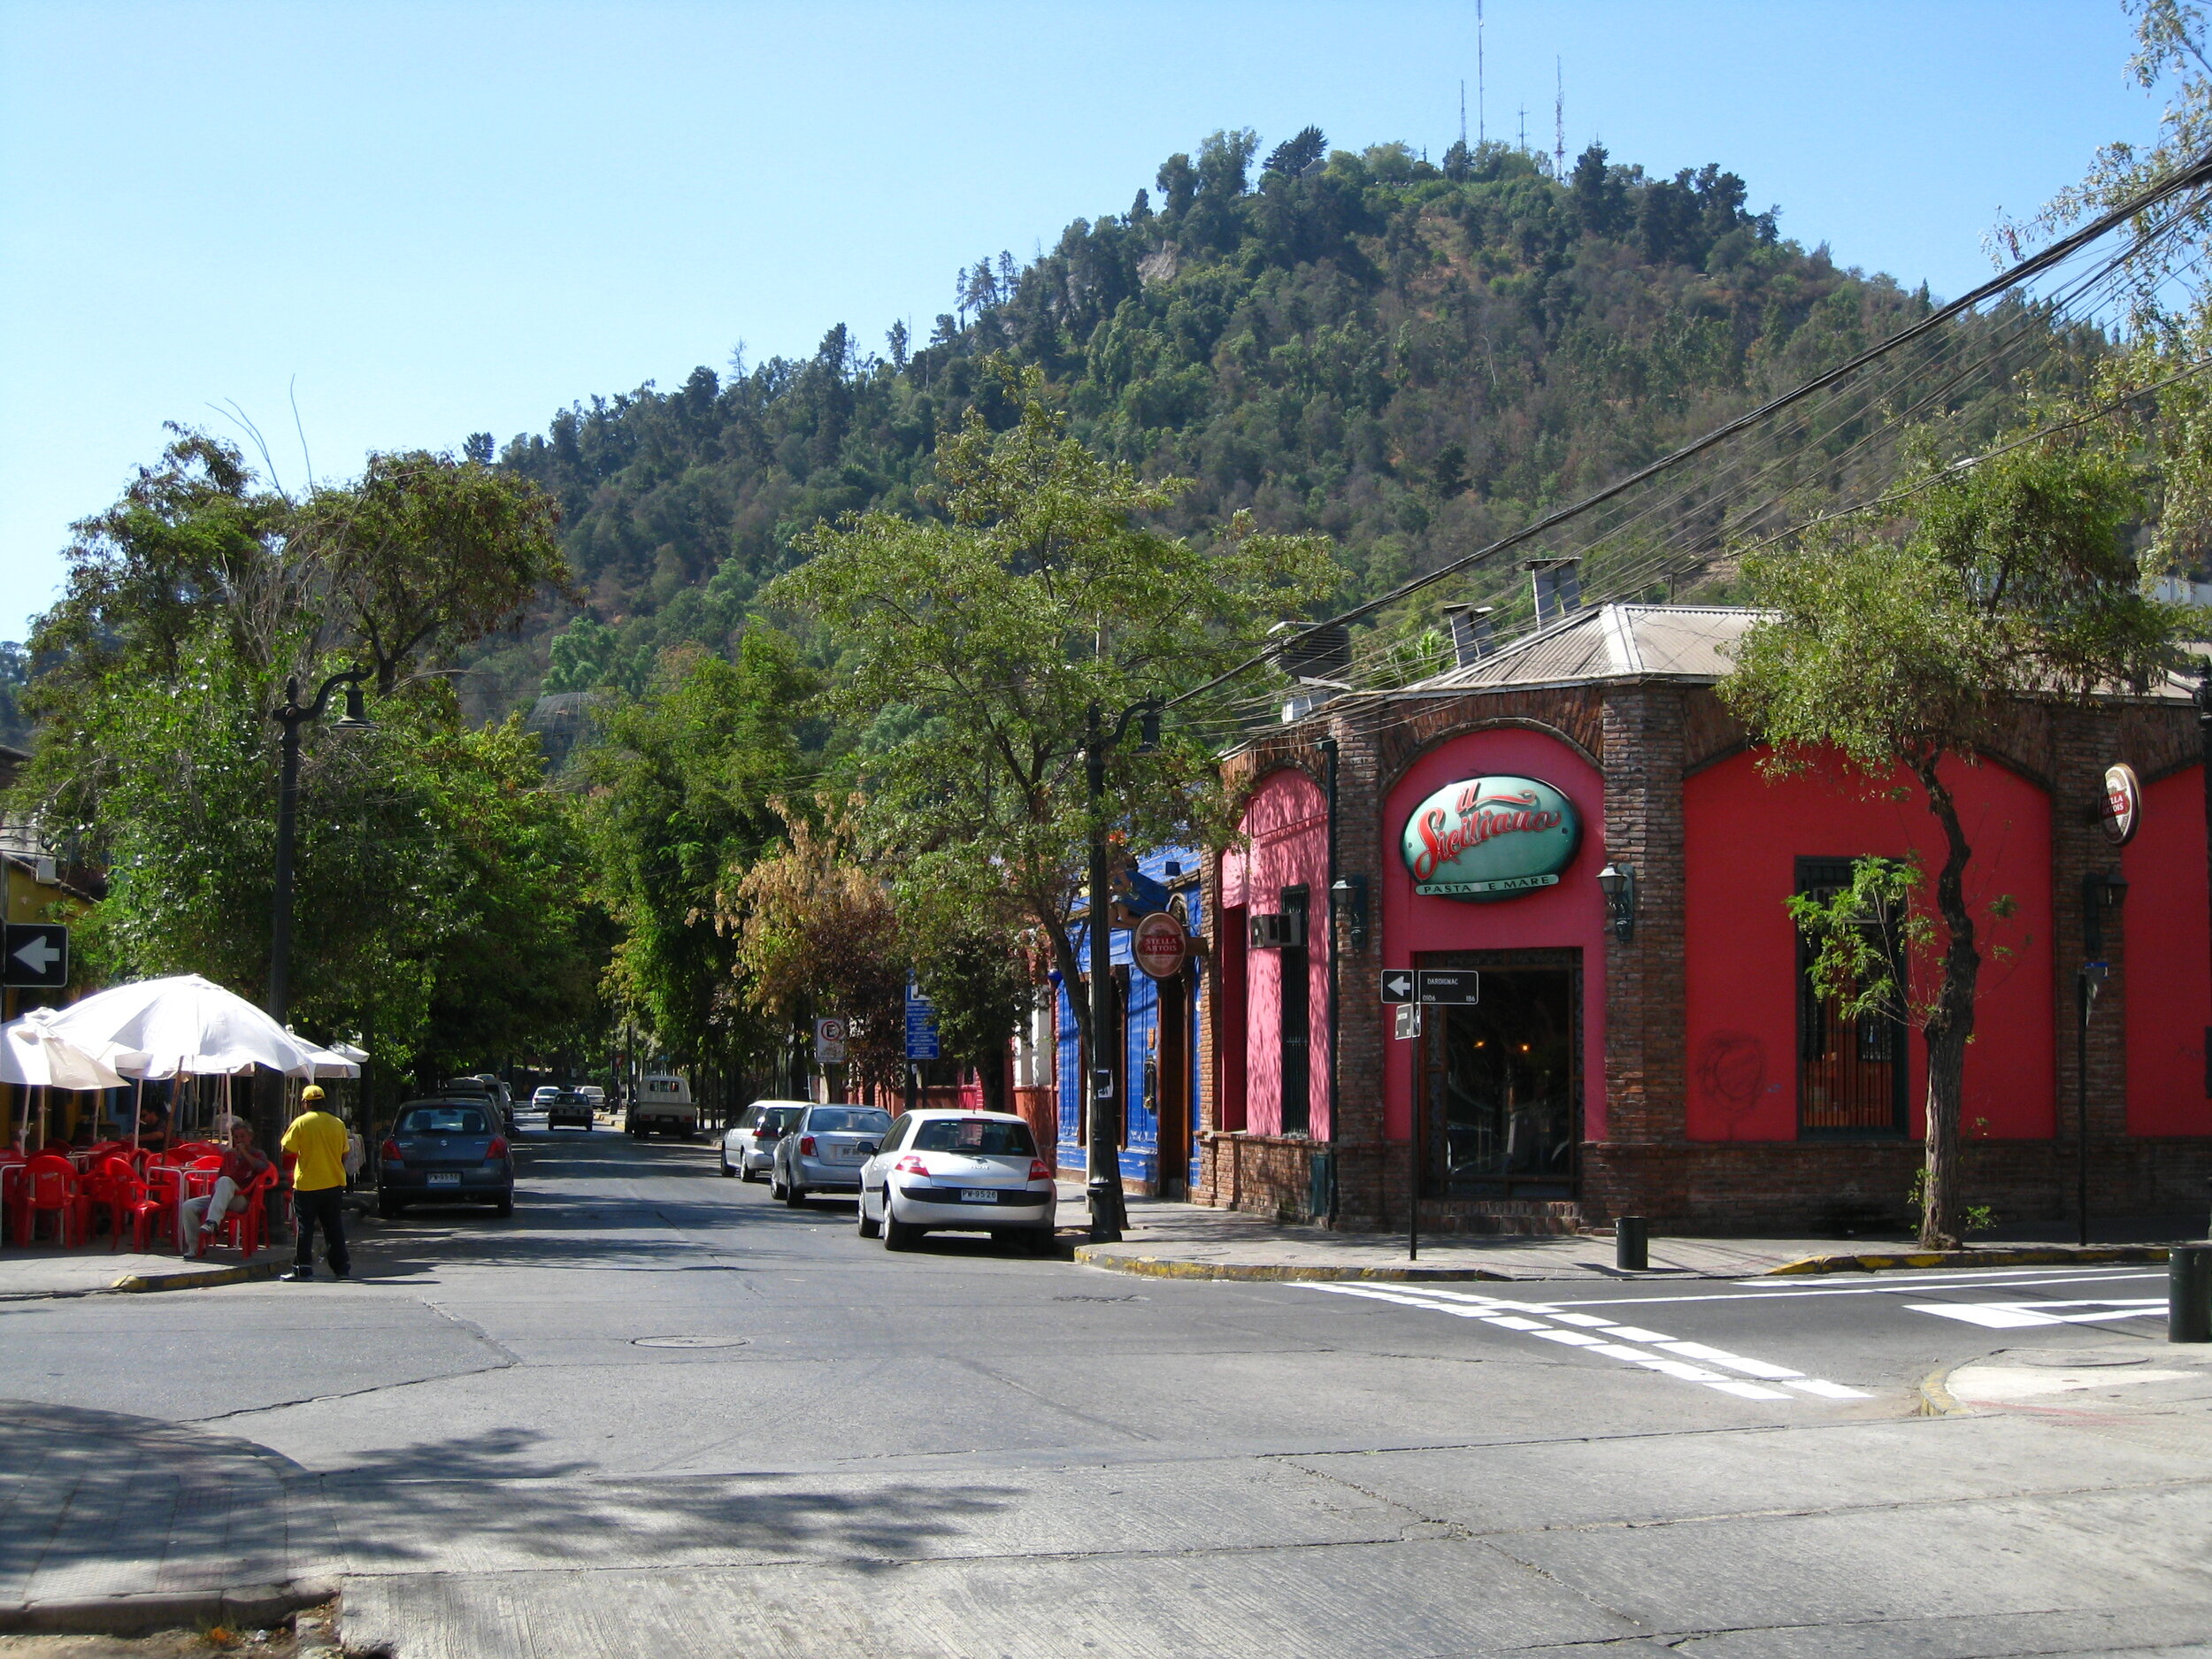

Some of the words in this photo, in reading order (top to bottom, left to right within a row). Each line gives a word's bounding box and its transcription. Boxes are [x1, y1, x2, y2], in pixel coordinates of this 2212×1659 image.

[1414, 807, 1562, 880] Siciliano
[1424, 885, 1471, 895] PASTA
[1488, 882, 1496, 891] E
[1504, 876, 1549, 888] MARE
